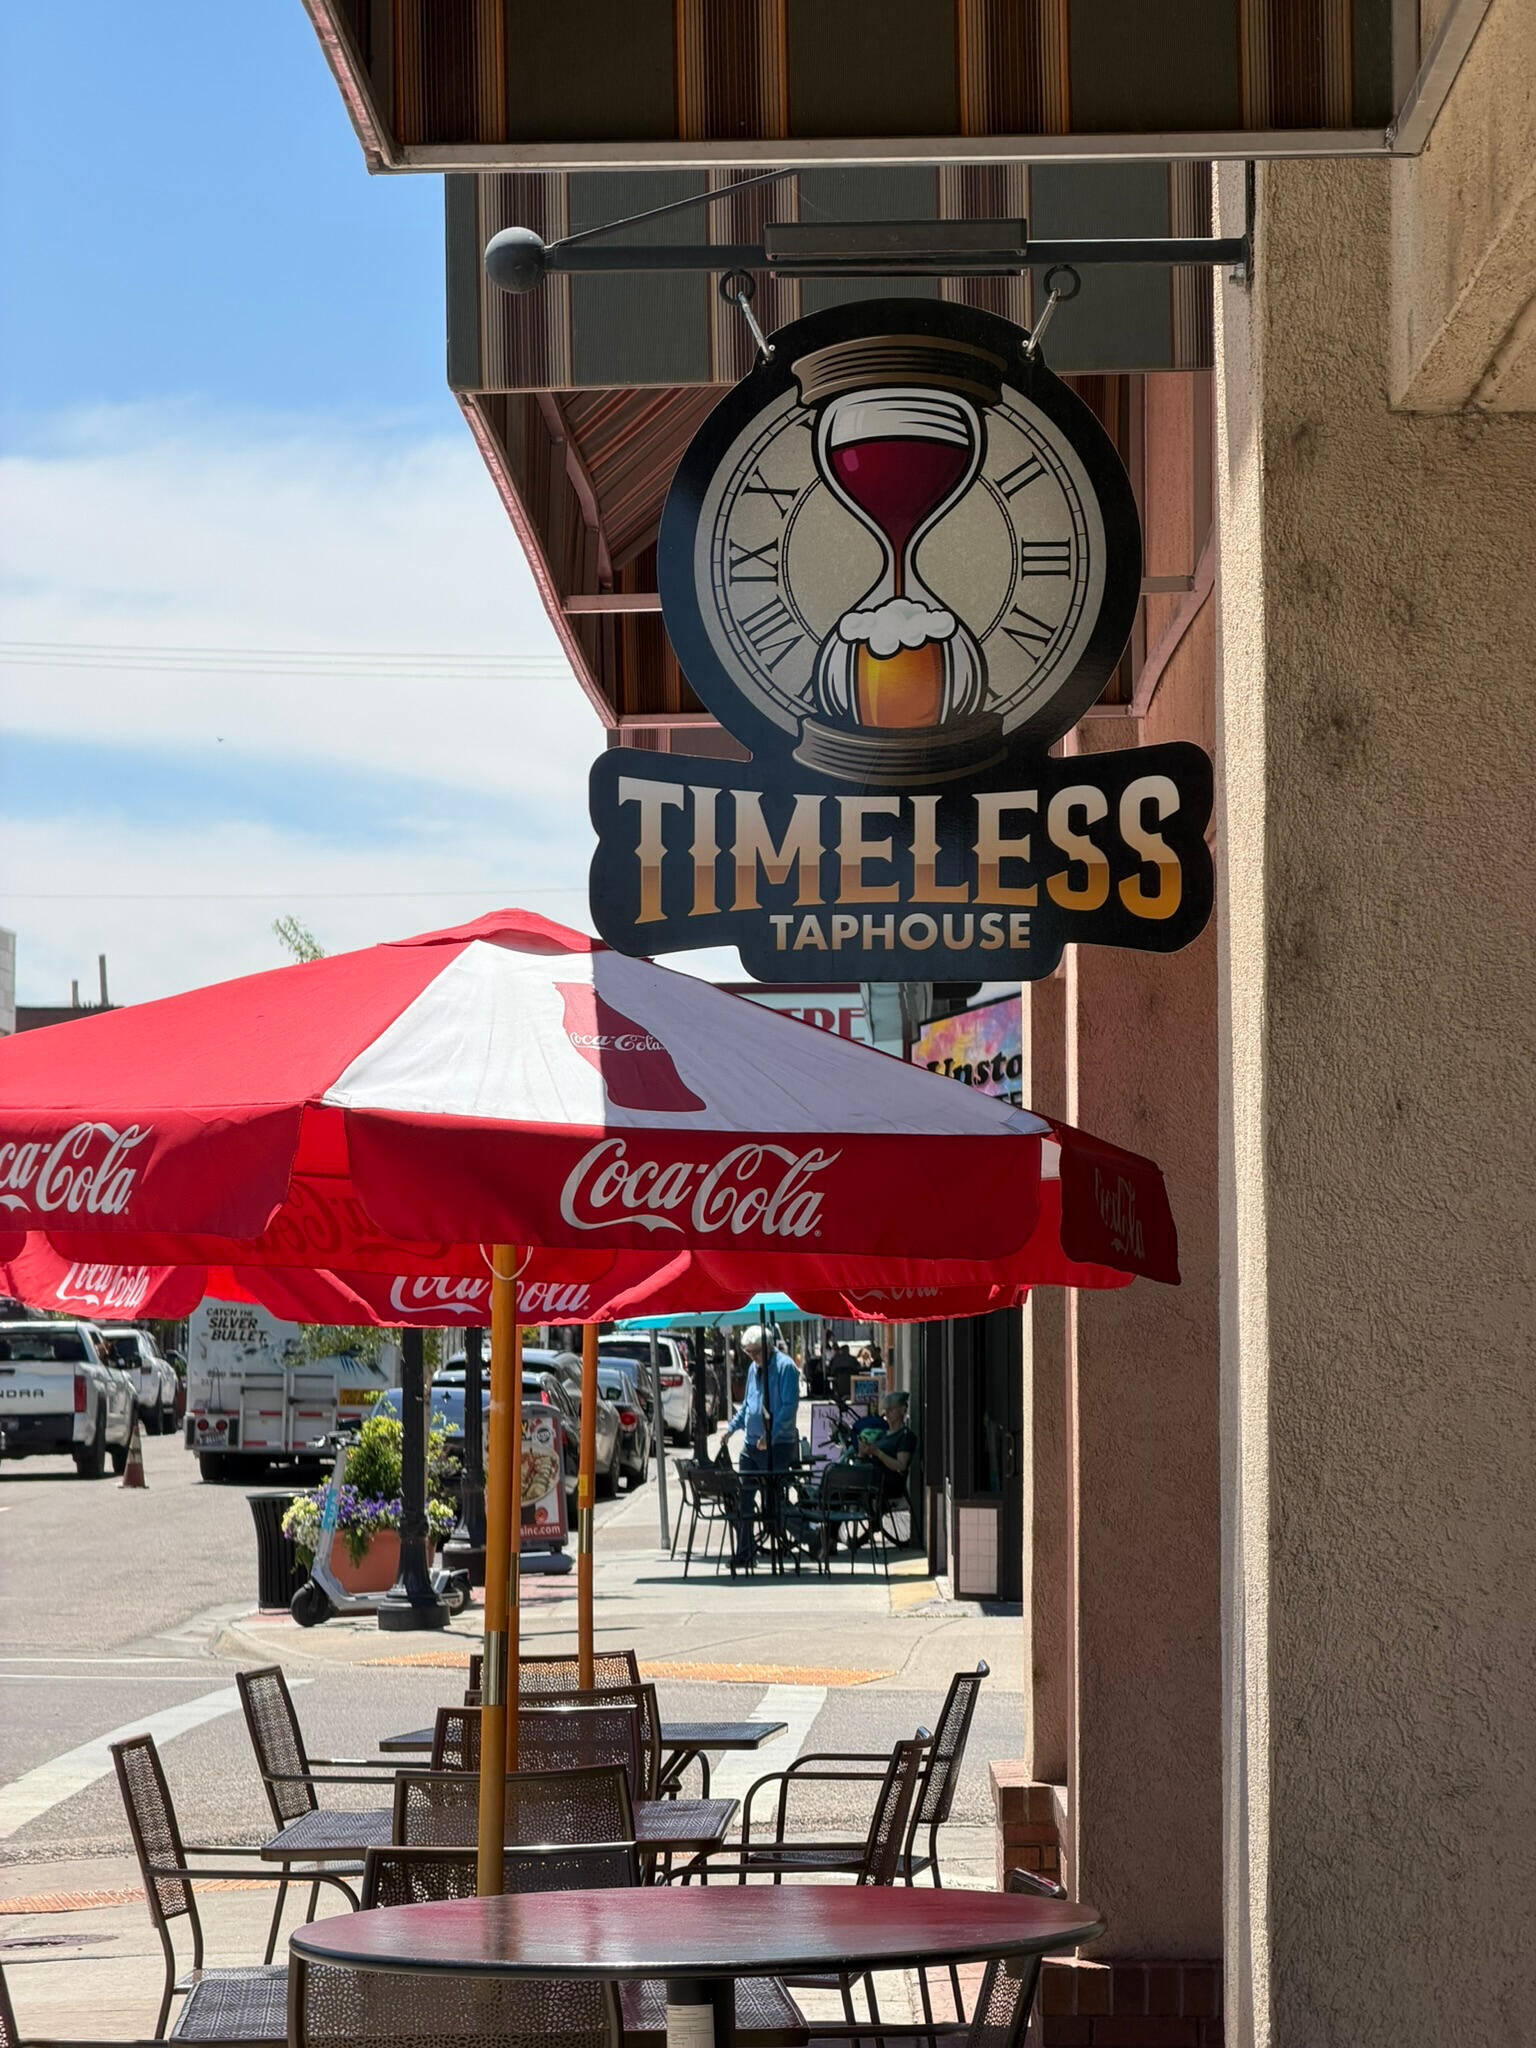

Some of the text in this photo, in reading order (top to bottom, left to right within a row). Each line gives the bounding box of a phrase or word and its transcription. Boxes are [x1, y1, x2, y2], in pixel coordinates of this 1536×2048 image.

[618, 774, 1182, 925] TIMELESS
[769, 912, 1032, 951] TAPHOUSE
[569, 1031, 667, 1051] Coca-Cola
[0, 1122, 153, 1215] ca-Cola
[560, 1137, 844, 1239] Coca-Cola
[206, 1307, 238, 1316] CATCH
[208, 1317, 258, 1329] SILVER
